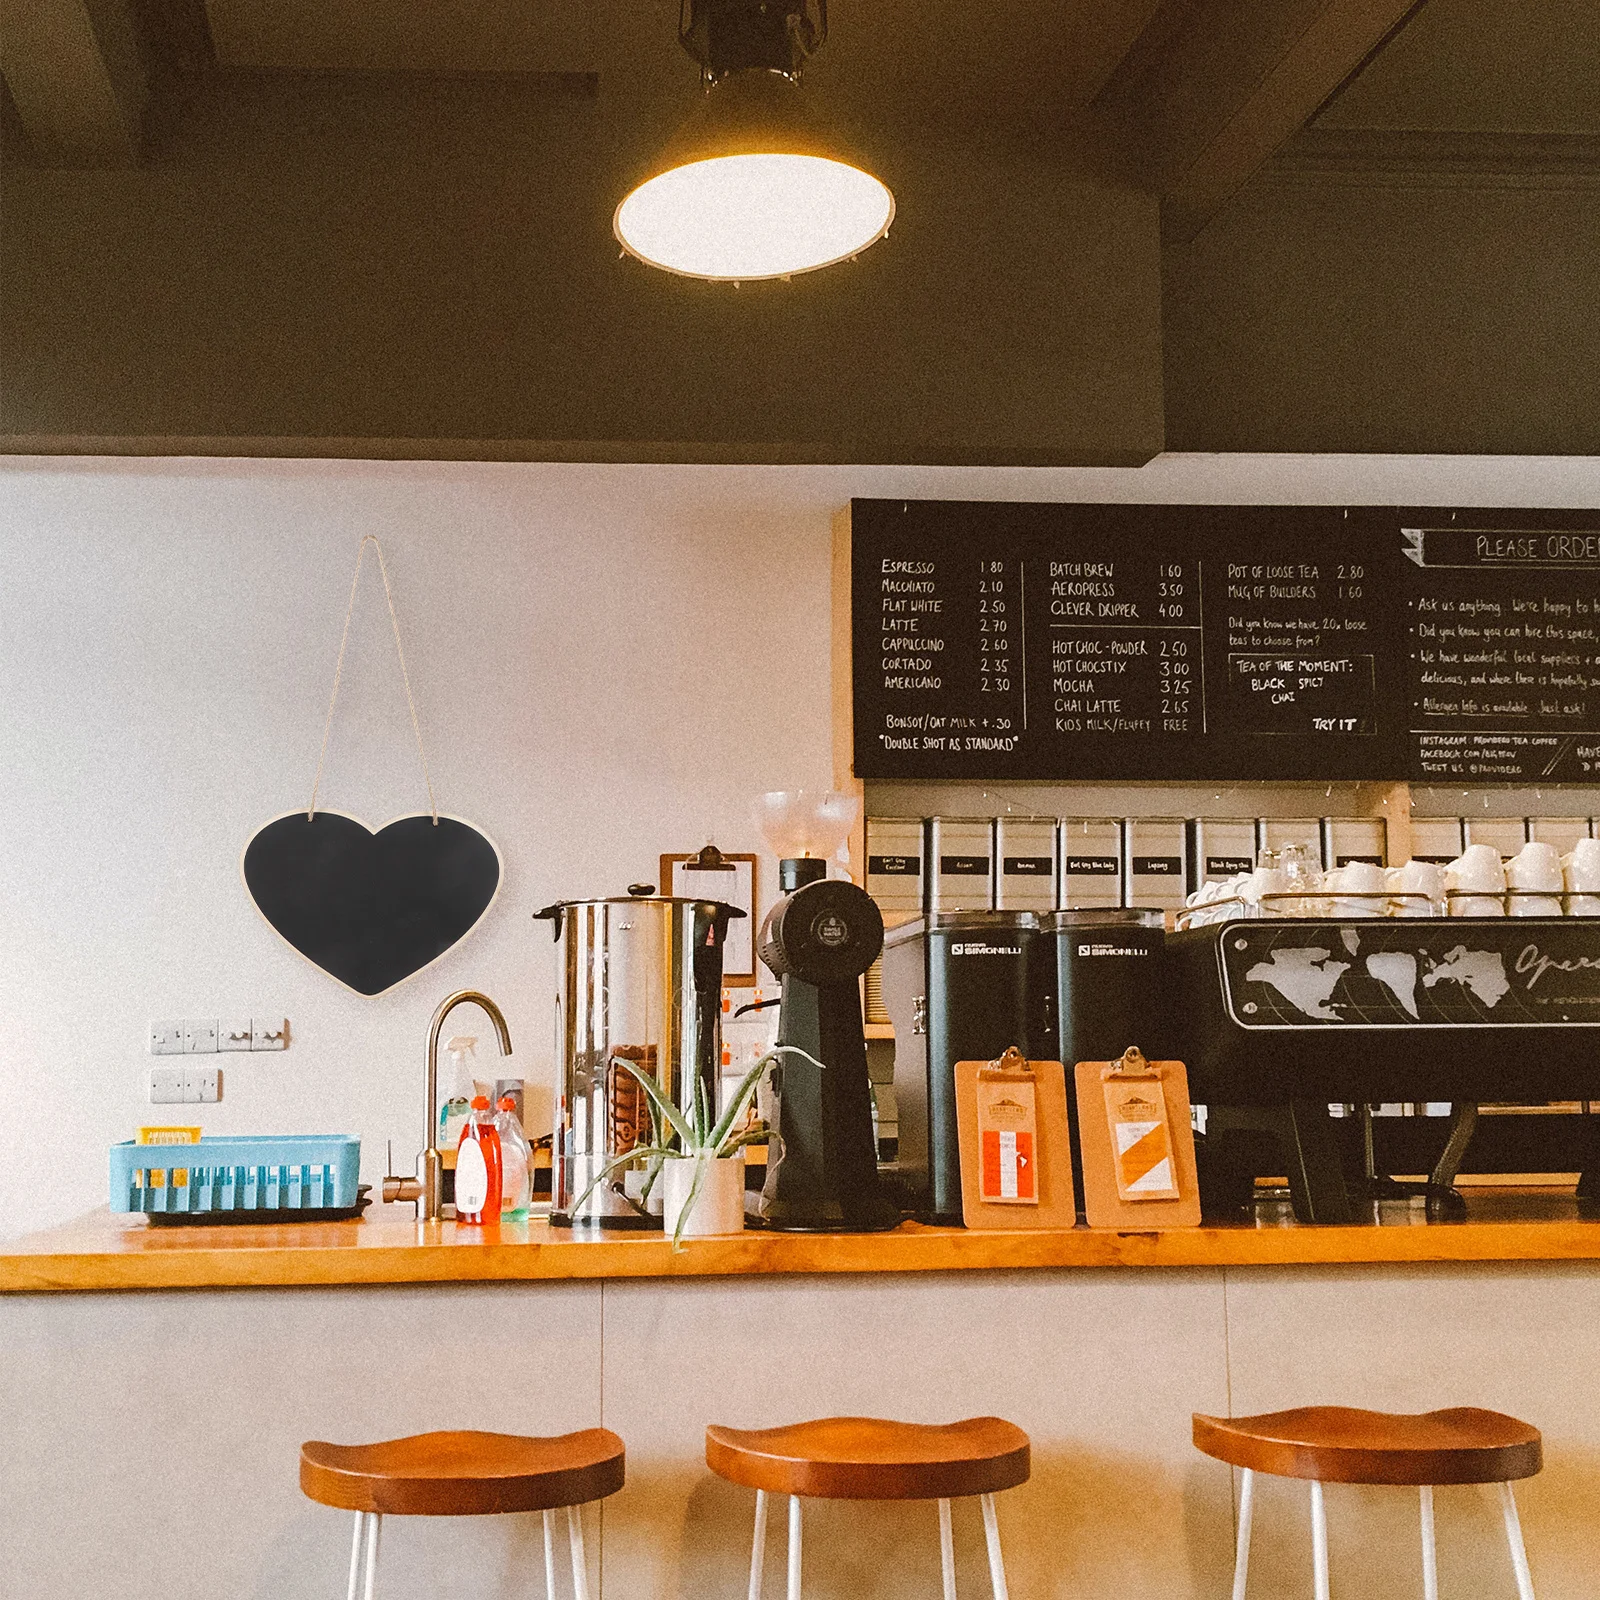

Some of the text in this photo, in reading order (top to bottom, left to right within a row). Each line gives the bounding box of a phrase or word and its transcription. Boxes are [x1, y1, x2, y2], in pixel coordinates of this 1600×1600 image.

[1477, 536, 1600, 558] PLEASE ORDE
[882, 559, 934, 573] ESPRESSO
[1050, 562, 1081, 577] BATCH
[1084, 563, 1113, 577] BREW
[1229, 564, 1247, 578] POT
[1252, 566, 1262, 578] OF
[1267, 566, 1294, 578] LOOSE
[1298, 565, 1319, 578] TEA
[882, 579, 934, 592] MACCHIATO
[1051, 582, 1115, 597] AEROPRESS
[1229, 586, 1250, 599] MUG
[1254, 587, 1264, 598] OF
[1270, 586, 1315, 598] BUILDERS
[883, 599, 907, 612] FLAT
[911, 600, 942, 612] WHITE
[1051, 601, 1094, 616] CLEVER
[1099, 604, 1139, 617] DRIPPER
[1418, 598, 1437, 611] Ask
[1442, 603, 1454, 611] us
[1544, 598, 1571, 617] happy
[1576, 599, 1588, 612] to
[882, 619, 918, 631] LATTE
[1229, 617, 1242, 628] Did
[1246, 620, 1261, 632] you
[1263, 618, 1282, 628] know
[1298, 619, 1319, 629] have
[1345, 618, 1367, 629] loose
[1419, 624, 1435, 637] Did
[1440, 628, 1455, 642] you
[1484, 628, 1501, 642] you
[1504, 628, 1520, 637] can
[882, 638, 944, 651] CAPPUCCINO
[1053, 641, 1074, 654] HOT
[1076, 641, 1102, 653] CHOC
[1230, 634, 1320, 648] teas to choose from?
[1421, 650, 1435, 662] We
[1440, 650, 1460, 662] have
[1514, 650, 1535, 662] local
[882, 658, 931, 670] CORTADO
[1053, 660, 1073, 672] HOT
[1237, 660, 1353, 672] TEA OF THE MOMENT:
[885, 678, 941, 689] AMERICANO
[1054, 678, 1094, 693] MOCHA
[1252, 677, 1324, 691] BLACK SPICY
[1272, 692, 1295, 704] CHAI
[1055, 699, 1081, 712] CHAI
[1087, 700, 1121, 713] LATTE
[950, 718, 976, 728] MILK
[1056, 718, 1081, 731] KIDS
[1164, 720, 1187, 731] FREE
[1313, 718, 1336, 730] TRY
[923, 737, 945, 750] SHOT
[950, 740, 960, 751] AS
[1512, 737, 1528, 745] TEA
[1452, 763, 1463, 772] US
